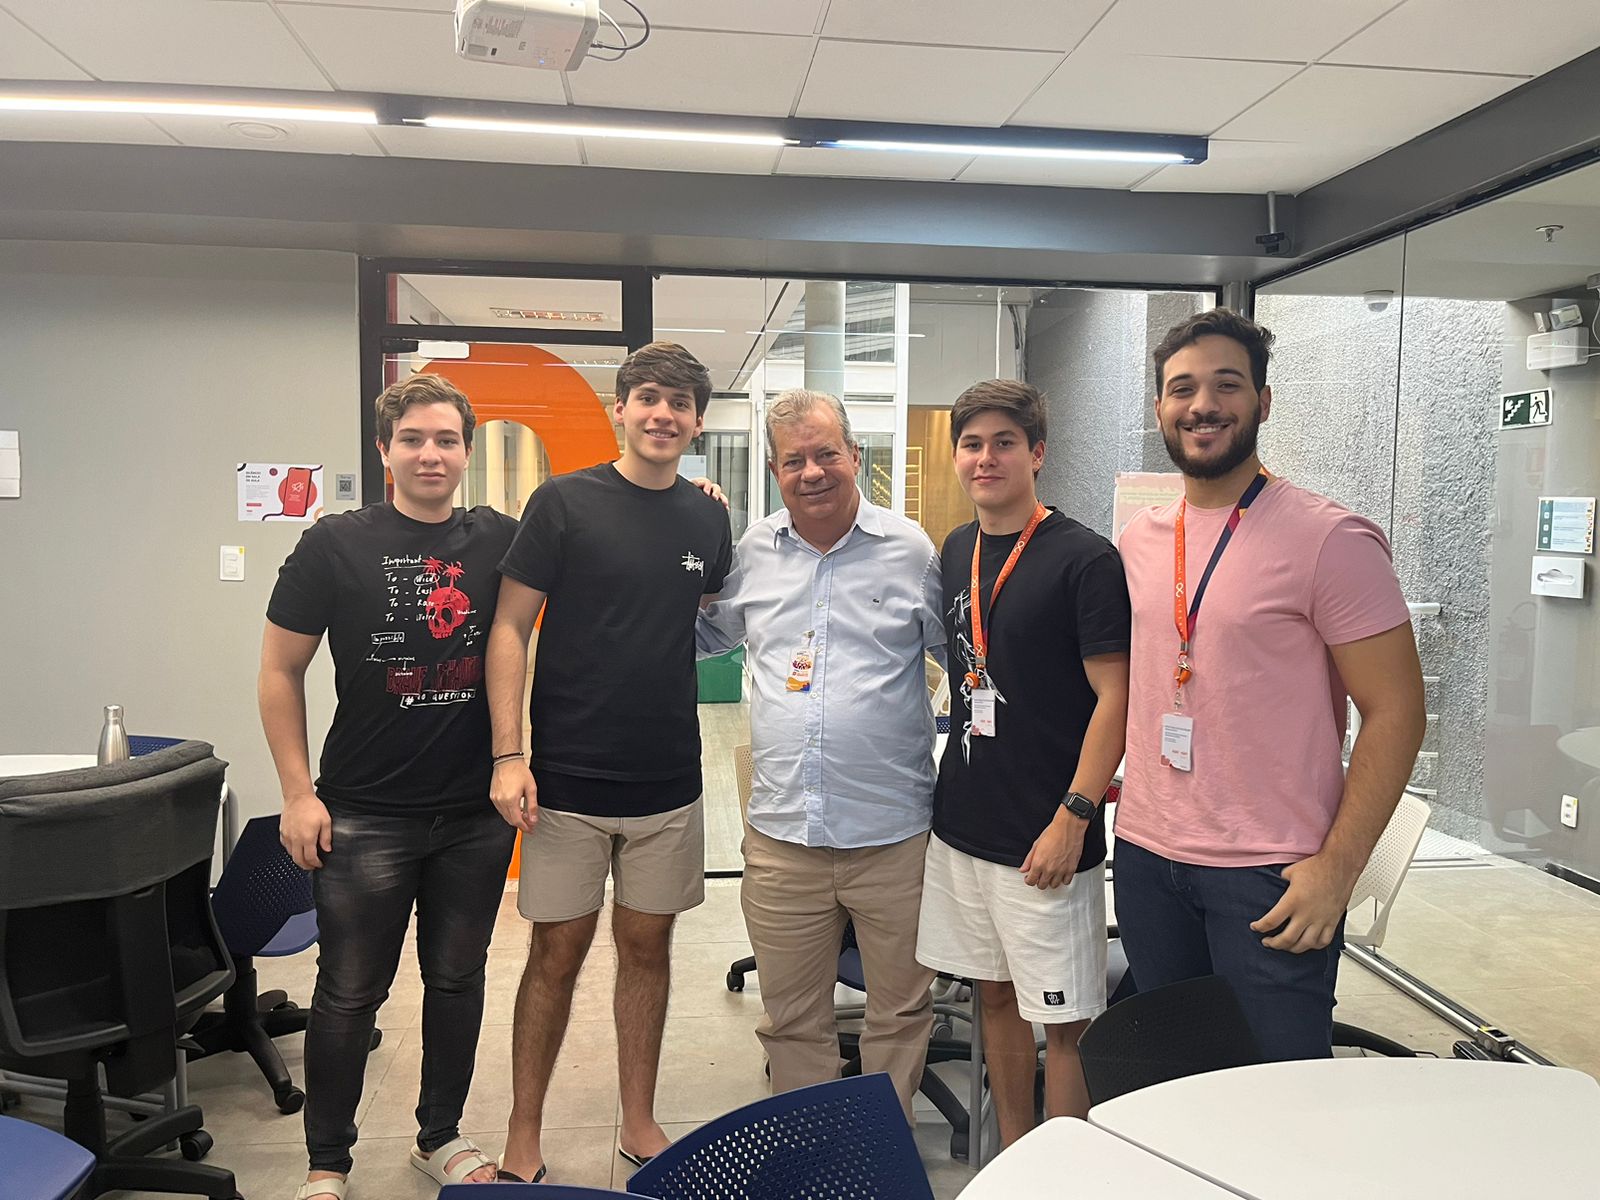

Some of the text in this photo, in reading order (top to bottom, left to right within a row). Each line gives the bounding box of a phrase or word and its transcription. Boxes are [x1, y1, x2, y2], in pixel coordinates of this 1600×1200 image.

[382, 555, 422, 567] Important
[385, 572, 397, 582] To
[387, 586, 399, 595] To
[389, 598, 399, 607] To
[385, 613, 395, 622] To
